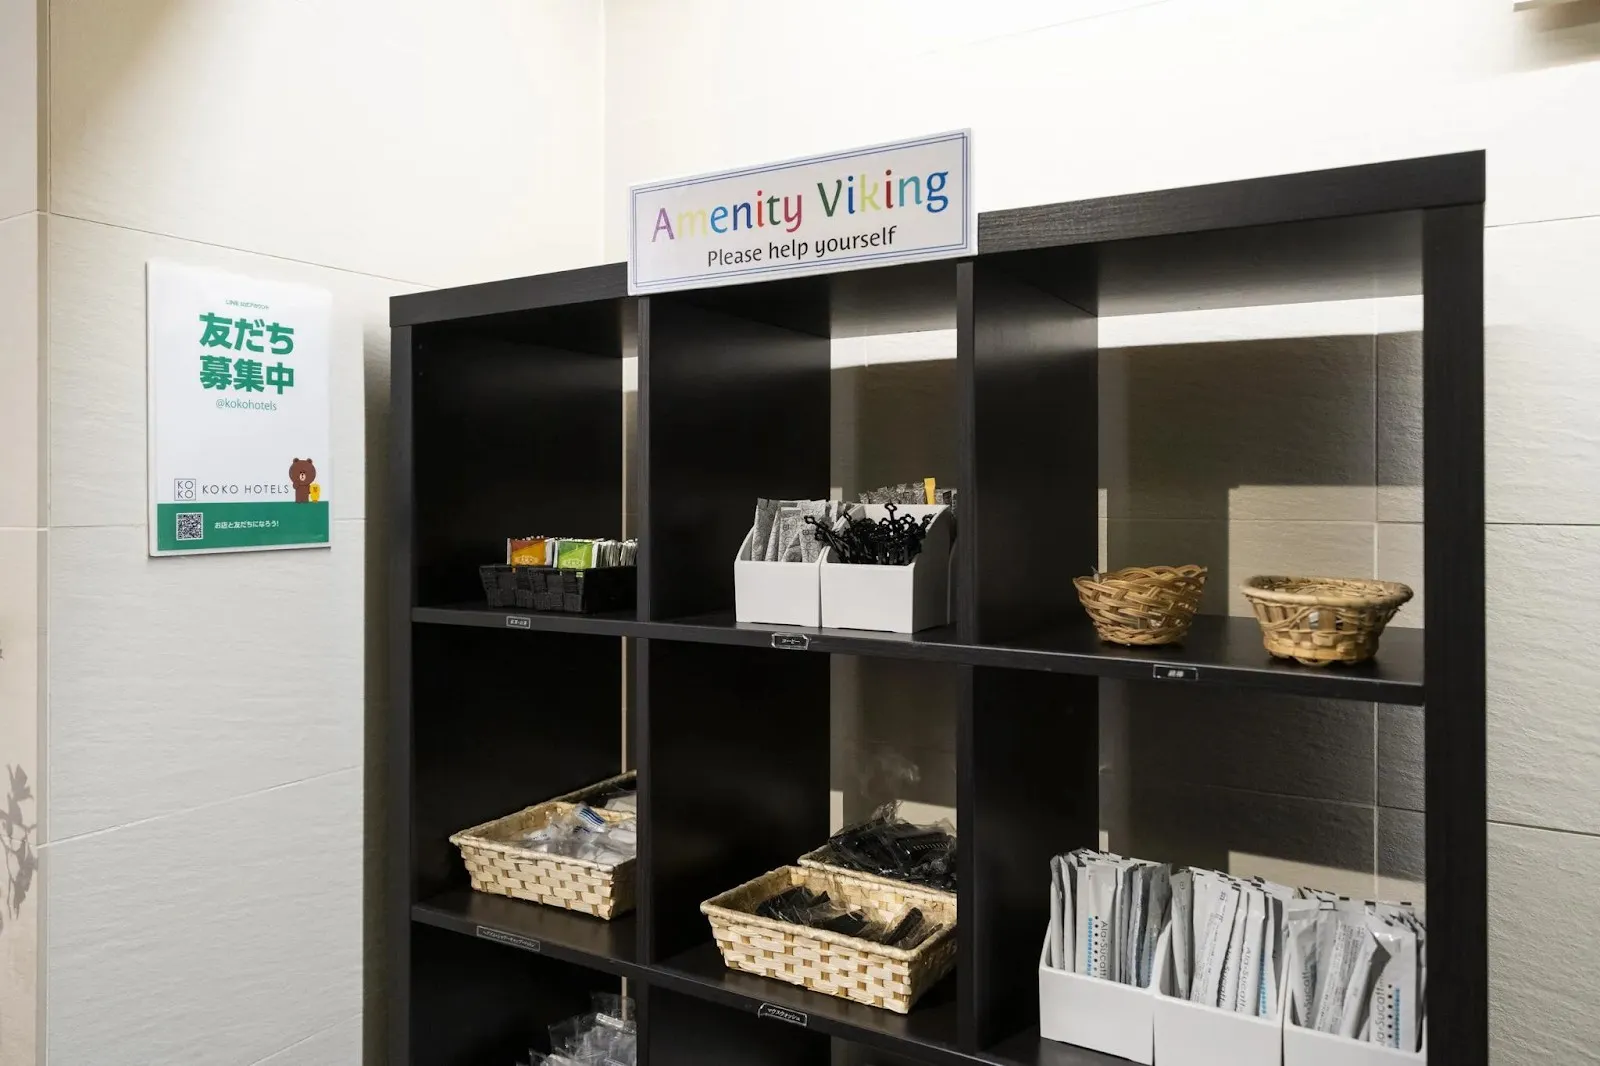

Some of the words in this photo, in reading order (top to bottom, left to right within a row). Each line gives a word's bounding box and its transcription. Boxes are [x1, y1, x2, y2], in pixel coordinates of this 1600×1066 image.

[651, 190, 802, 242] Amenity
[817, 169, 949, 217] Viking
[708, 246, 762, 267] Please
[769, 238, 808, 260] help
[815, 225, 897, 257] yourself
[199, 312, 294, 355] 友だち
[199, 355, 294, 395] 募集中
[216, 399, 277, 411] @kokohotels
[202, 484, 239, 495] KOKO
[244, 484, 289, 495] HOTELS
